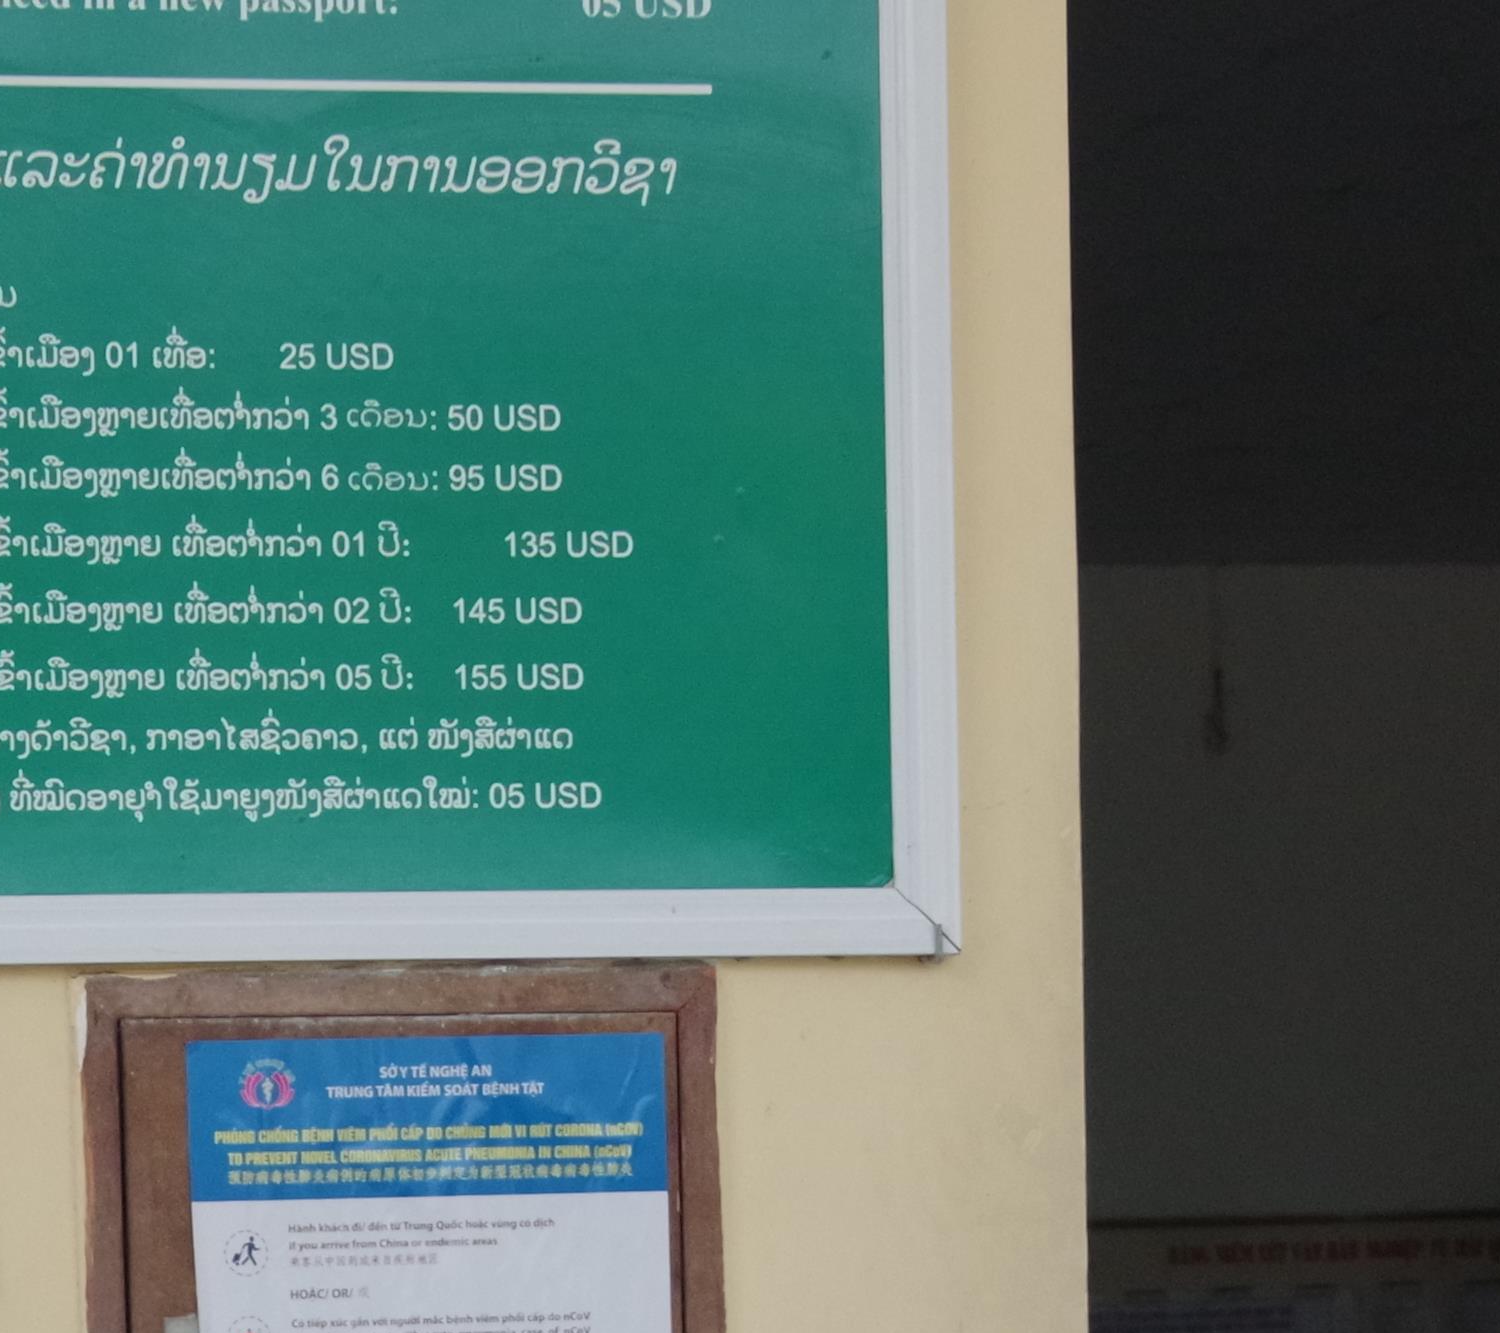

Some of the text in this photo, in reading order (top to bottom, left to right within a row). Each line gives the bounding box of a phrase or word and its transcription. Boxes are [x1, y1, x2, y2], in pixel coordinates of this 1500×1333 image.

[635, 0, 711, 18] USD
[106, 341, 137, 368] 01
[280, 343, 316, 369] 25
[327, 343, 394, 370] USD
[321, 403, 338, 430] 3
[448, 404, 483, 431] 50
[494, 404, 561, 431] USD
[321, 463, 339, 491] 6
[449, 464, 484, 491] 95
[495, 464, 562, 491] USD
[332, 531, 364, 557] 01
[505, 531, 556, 558] 135
[567, 531, 633, 558] USD
[334, 597, 370, 624] 02
[454, 598, 505, 624] 145
[516, 597, 582, 624] USD
[336, 664, 372, 690] 05
[455, 664, 507, 690] 155
[517, 663, 584, 690] USD
[489, 783, 525, 808] 05
[535, 782, 602, 809] USD
[380, 1063, 491, 1079] SỞ Y TẾ NGHỆ AN
[327, 1081, 544, 1098] TRUNG TÂM KIỂM SOÁT BỆNH TẬT
[299, 1243, 318, 1252] you
[321, 1240, 351, 1249] arrive
[352, 1240, 377, 1248] from
[379, 1238, 408, 1248] China
[472, 1238, 497, 1246] areas
